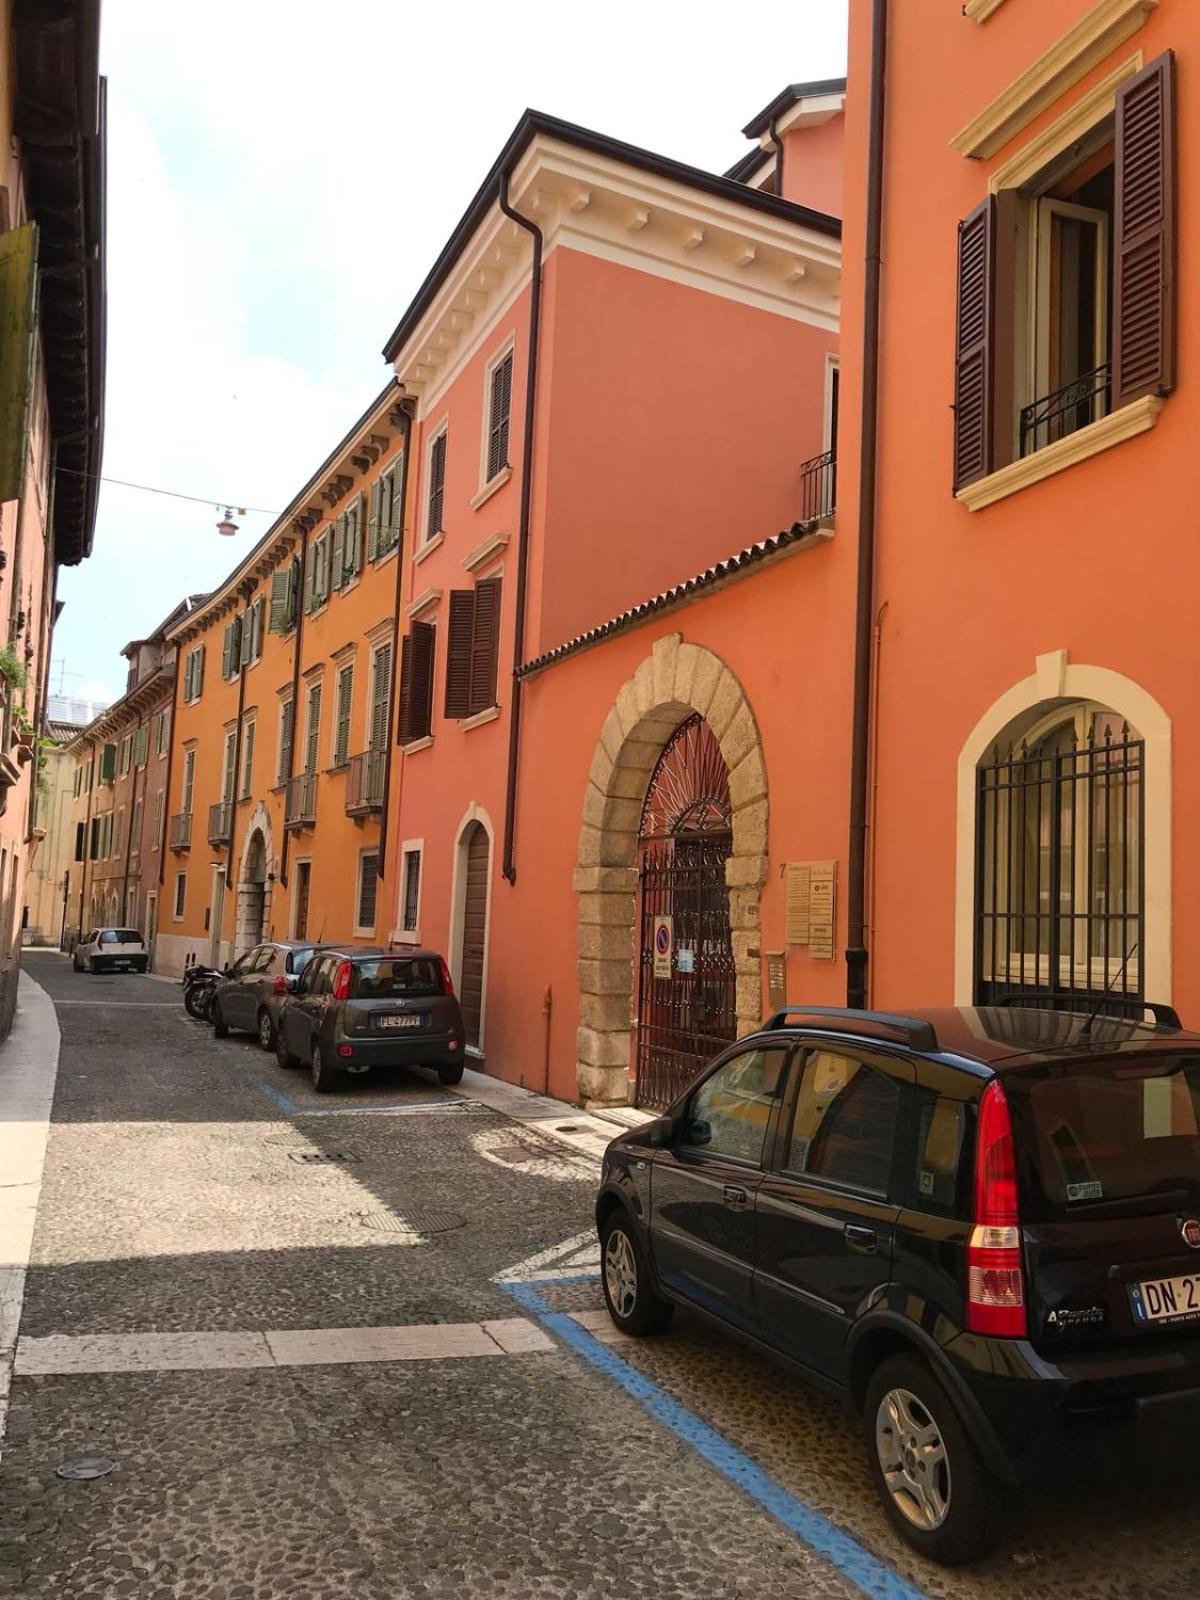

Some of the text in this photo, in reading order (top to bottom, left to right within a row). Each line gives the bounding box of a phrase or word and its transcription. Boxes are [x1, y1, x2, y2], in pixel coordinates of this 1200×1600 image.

[780, 863, 786, 879] 7
[1145, 1276, 1200, 1315] DN 2
